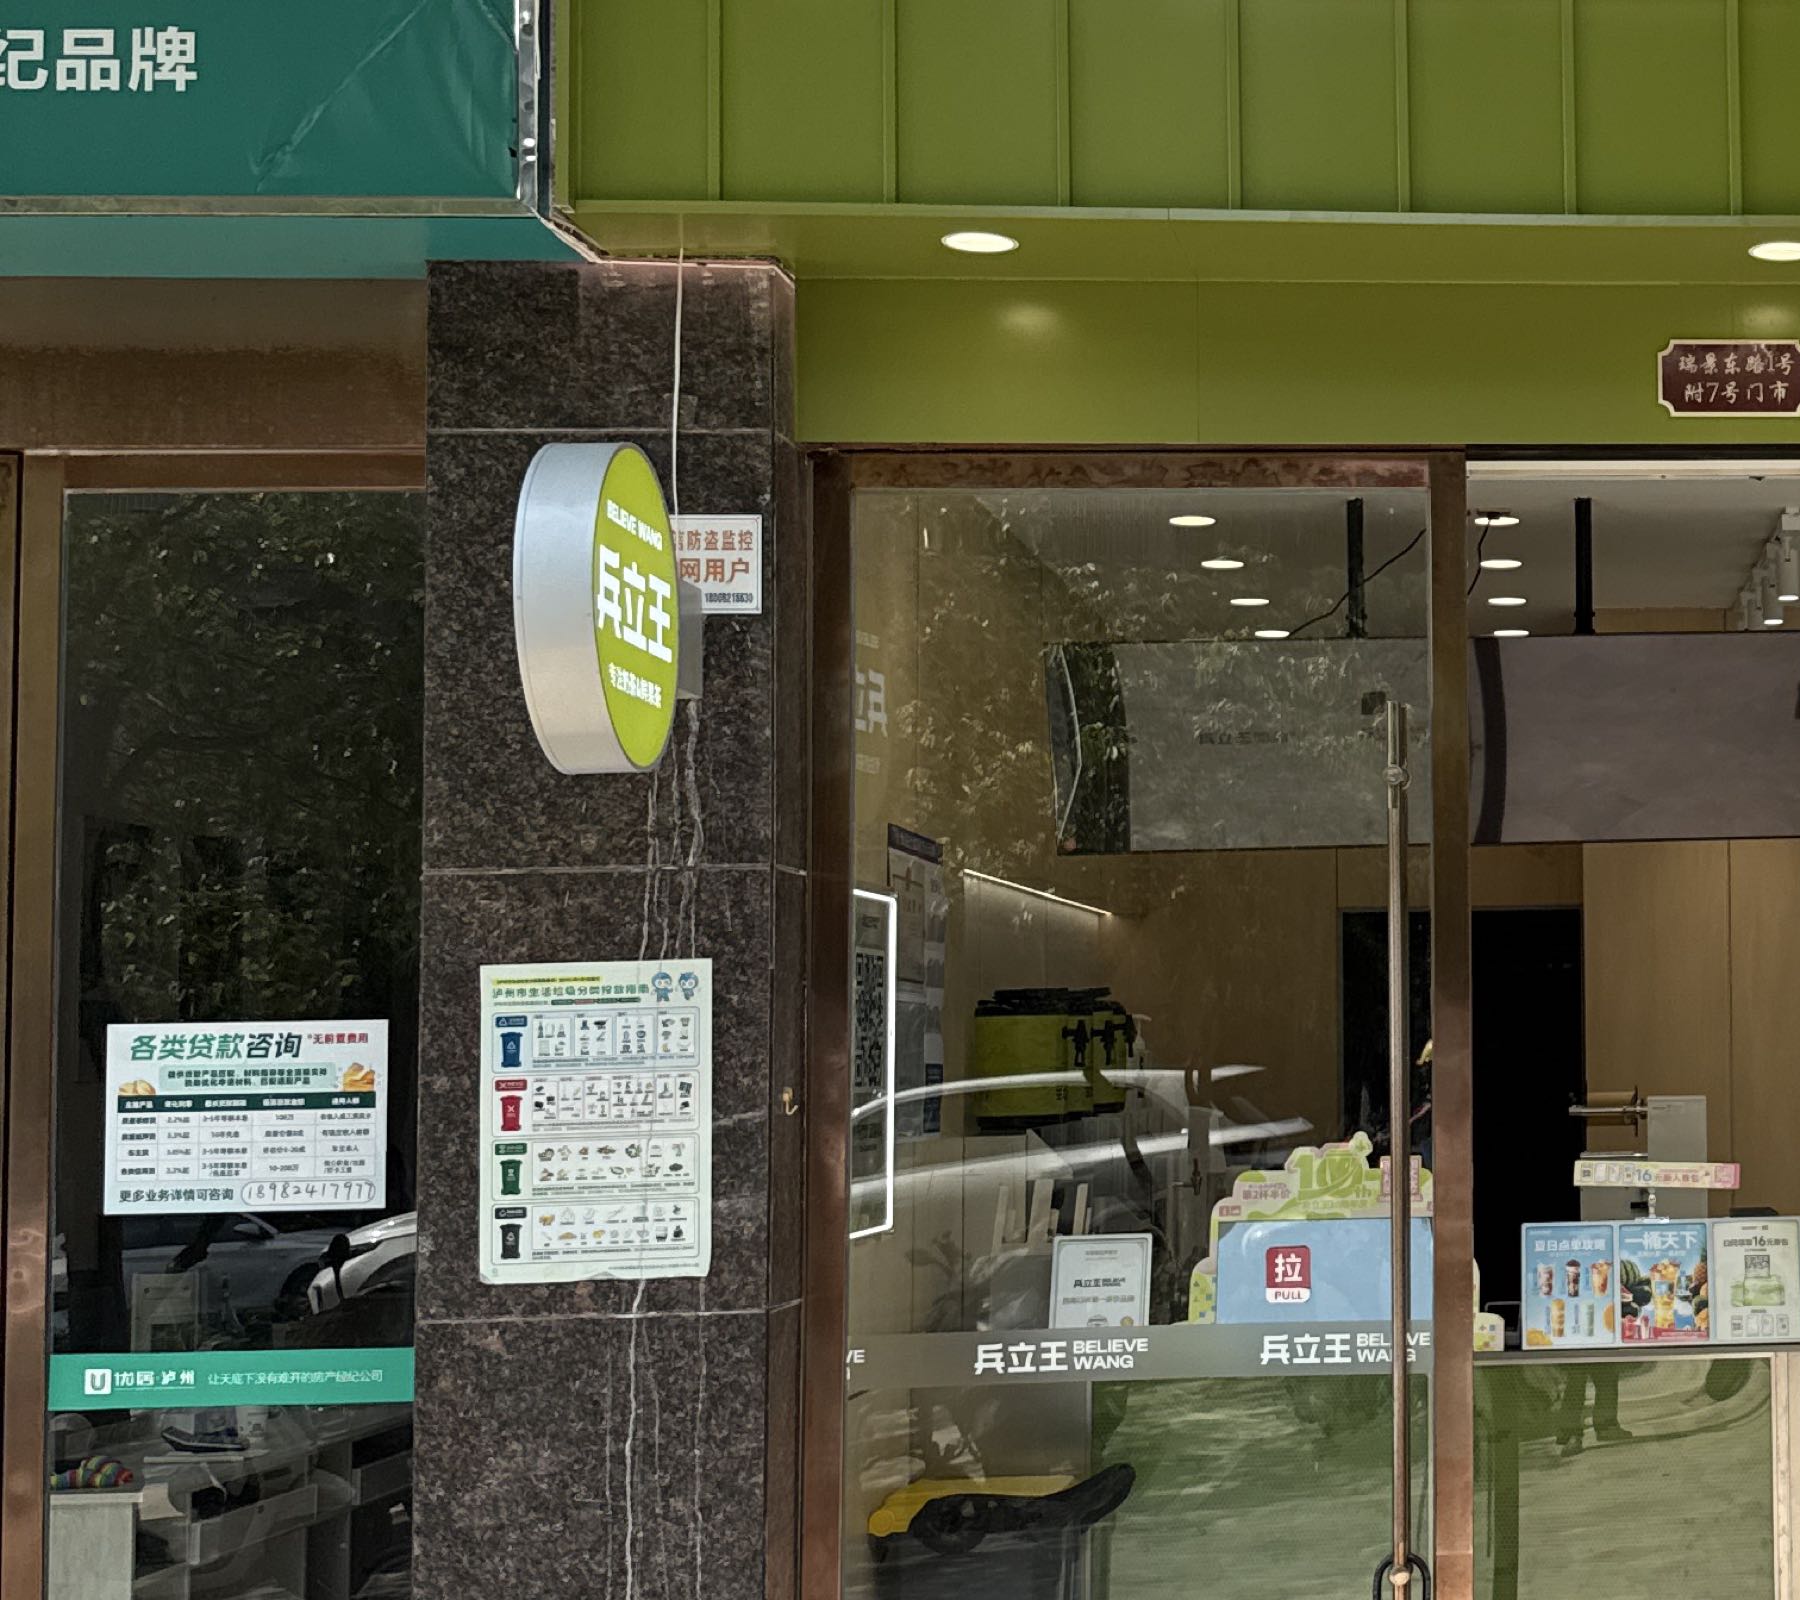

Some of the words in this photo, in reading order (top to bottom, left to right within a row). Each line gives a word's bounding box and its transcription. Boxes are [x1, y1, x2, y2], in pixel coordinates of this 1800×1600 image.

[1684, 381, 1789, 404] 附7号门市
[597, 544, 672, 664] 兵立王
[131, 1032, 303, 1061] 各类贷款咨询
[119, 1188, 234, 1203] 更多业务详情可咨询
[1274, 1253, 1303, 1283] 拉
[1274, 1290, 1303, 1300] PULL
[1073, 1338, 1149, 1354] BELIEVE
[1260, 1332, 1352, 1366] 兵立王
[1356, 1332, 1431, 1347] BELVE
[974, 1341, 1069, 1376] 兵立王
[1073, 1355, 1134, 1371] WANG
[1357, 1348, 1416, 1363] WAG
